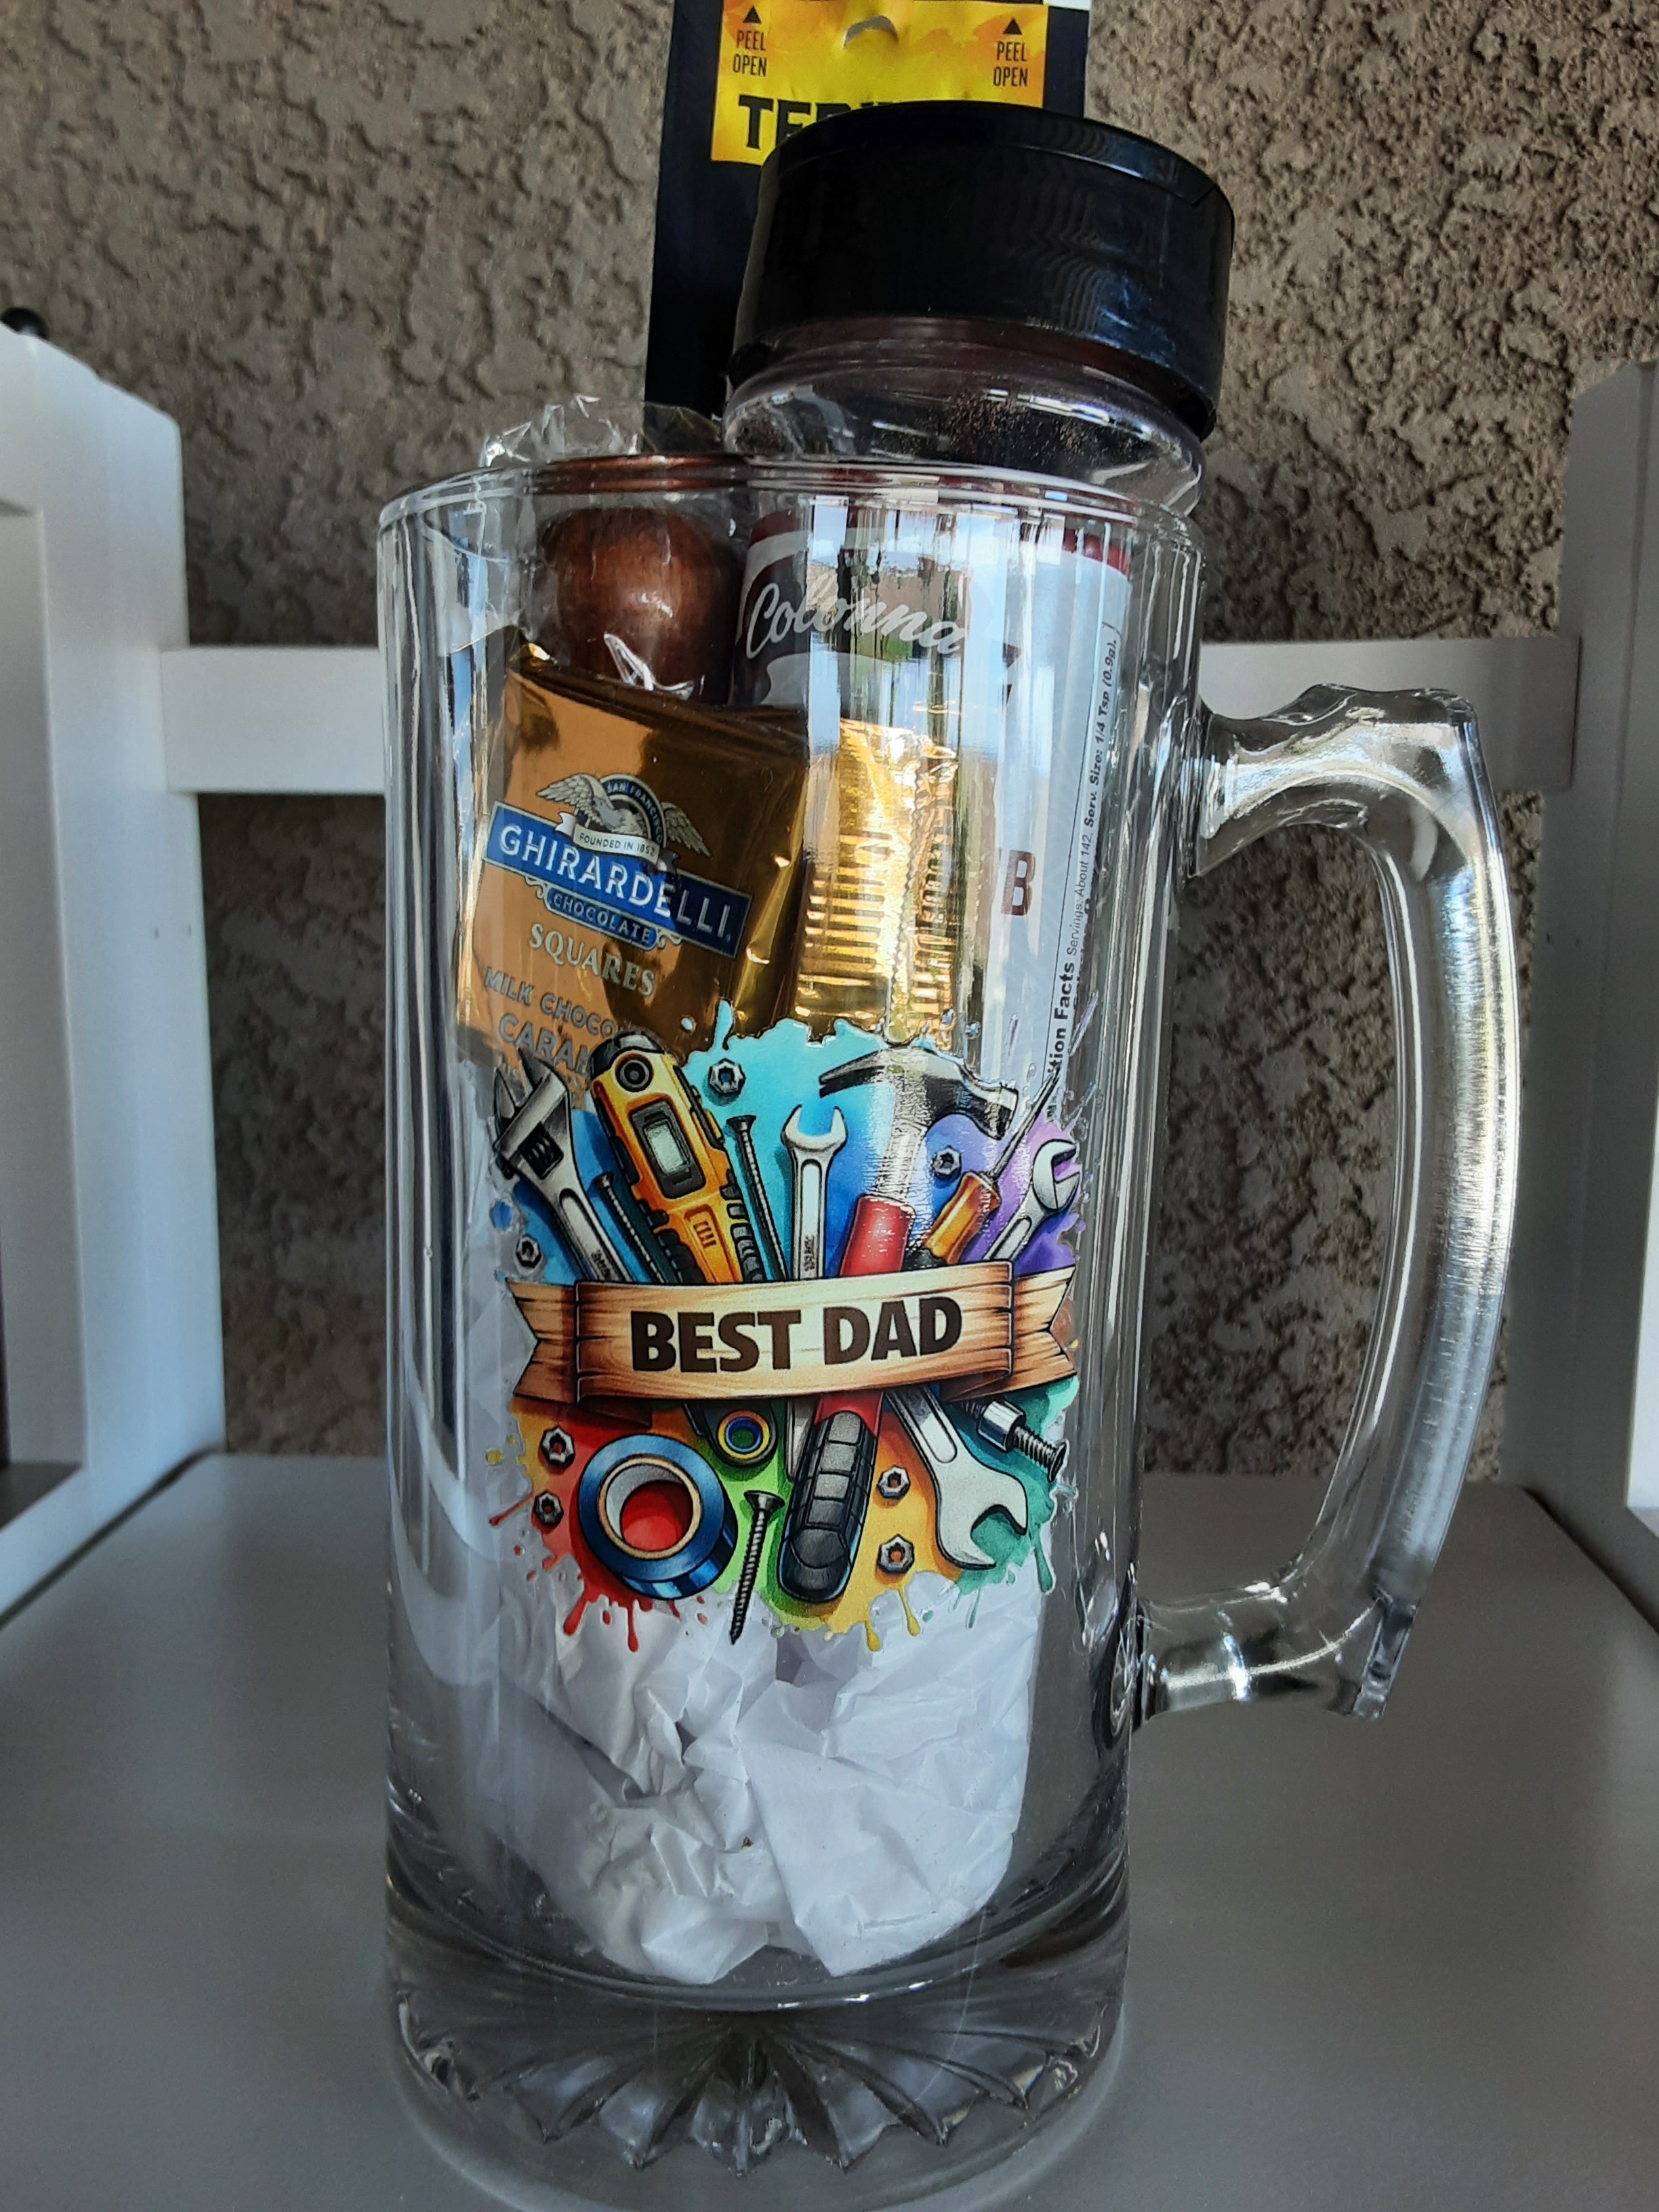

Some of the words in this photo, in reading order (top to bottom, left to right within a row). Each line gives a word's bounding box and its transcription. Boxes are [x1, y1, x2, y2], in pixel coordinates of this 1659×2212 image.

[736, 29, 766, 52] PEEL
[996, 41, 1027, 62] PEEL
[732, 54, 767, 77] OPEN
[993, 66, 1029, 87] OPEN
[1098, 691, 1110, 716] Tsp
[1094, 721, 1105, 744] 1/4
[1089, 748, 1103, 786] Size:
[1084, 791, 1097, 828] Serv.
[579, 832, 621, 849] FOUNDED
[623, 841, 634, 851] IN
[637, 842, 655, 857] 1852
[499, 823, 731, 939] GHIRARDELLI
[1074, 861, 1089, 898] About
[553, 893, 652, 944] CHOCOLATE
[529, 922, 656, 996] SQUARES
[485, 966, 535, 1006] MILK
[540, 992, 618, 1040] CHOCO
[1054, 962, 1075, 1020] Facts
[630, 1309, 802, 1374] BEST
[823, 1296, 963, 1366] DAD
